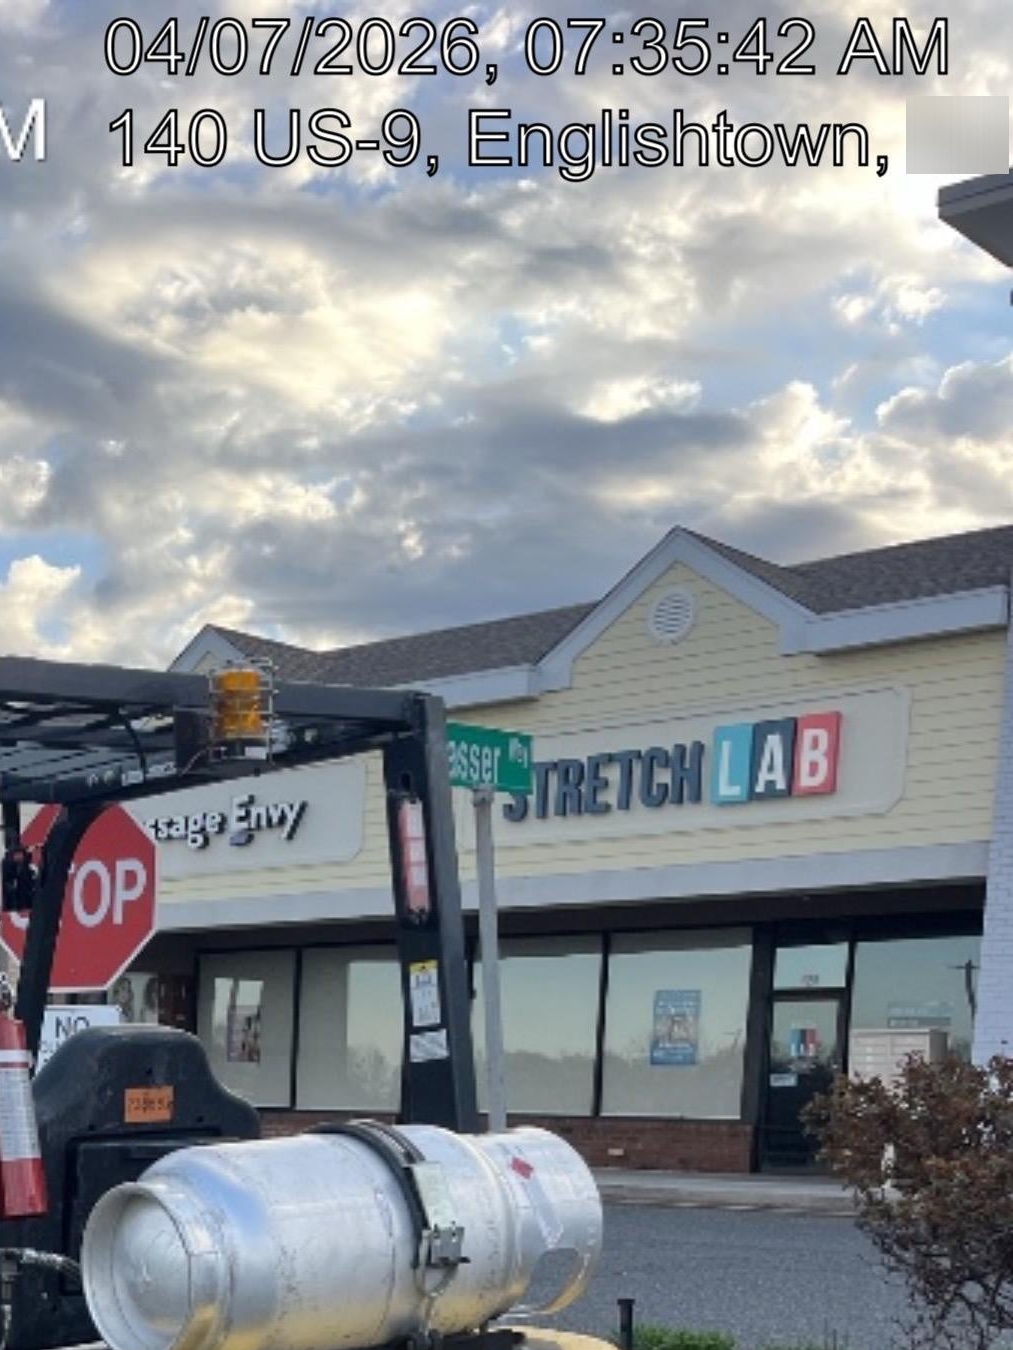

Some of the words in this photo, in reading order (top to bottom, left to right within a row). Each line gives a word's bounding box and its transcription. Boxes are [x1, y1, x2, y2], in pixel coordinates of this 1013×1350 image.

[717, 725, 830, 798] LAB
[231, 794, 307, 840] Envy
[10, 859, 147, 929] OP
